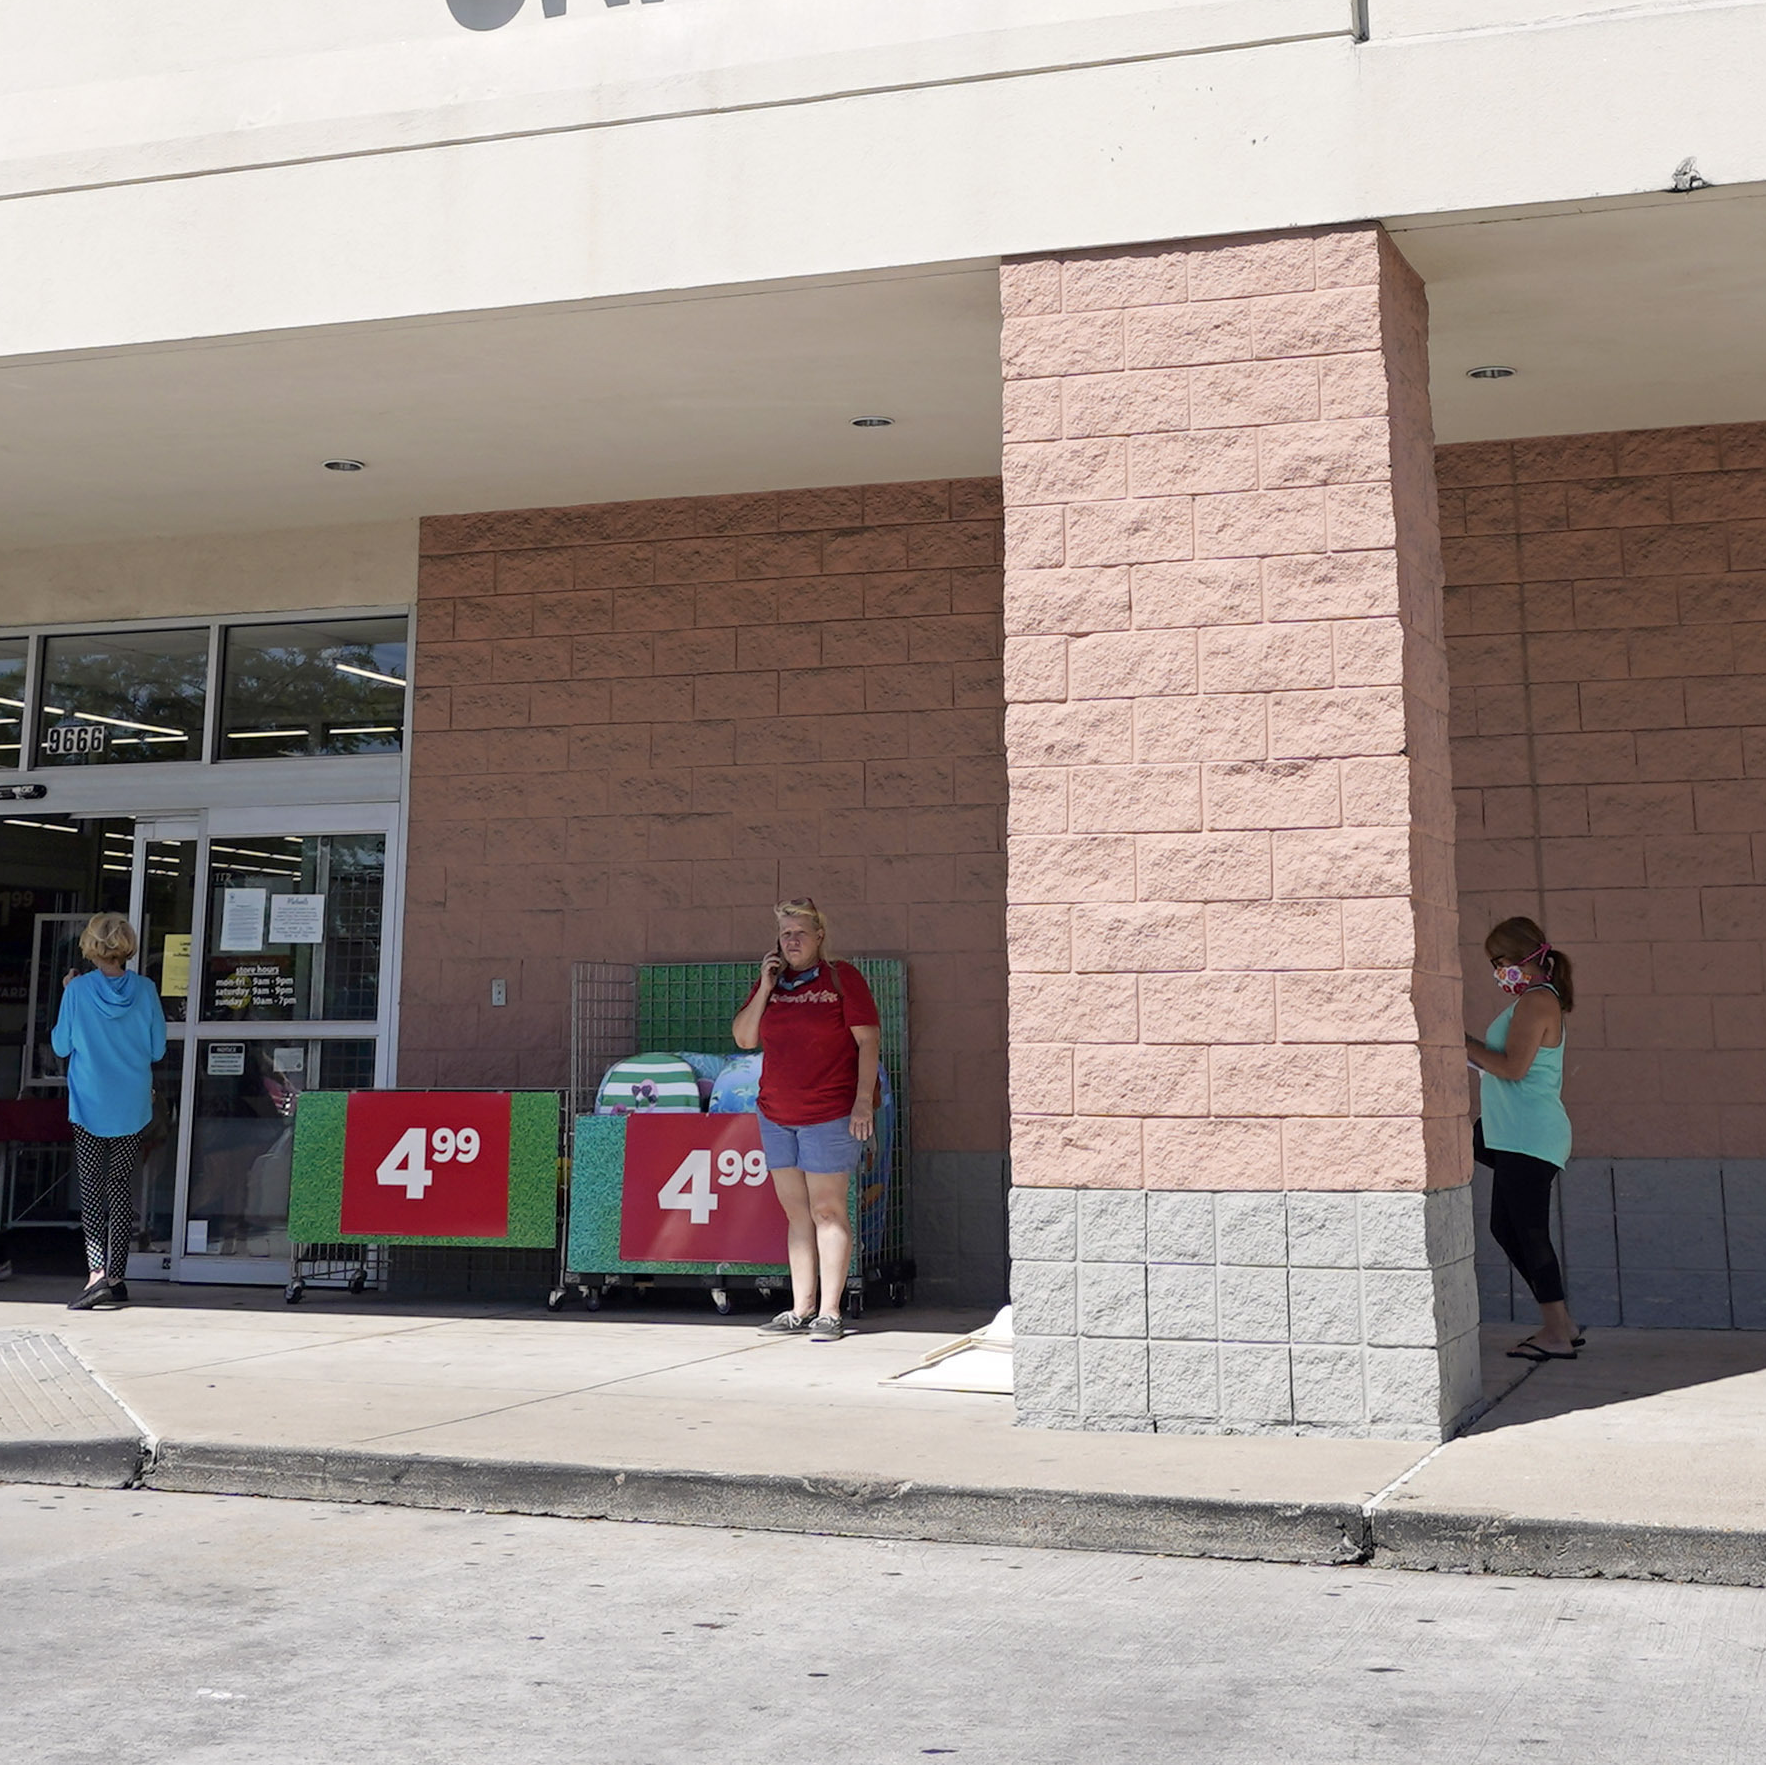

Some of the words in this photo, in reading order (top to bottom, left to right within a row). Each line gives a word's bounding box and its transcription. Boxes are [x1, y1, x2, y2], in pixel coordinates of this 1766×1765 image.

[49, 727, 102, 753] 9666
[236, 966, 256, 975] store
[257, 965, 280, 975] hours
[252, 977, 270, 986] 9am
[275, 976, 294, 986] 9pm
[215, 987, 250, 997] saturday
[252, 987, 270, 995] 9am
[275, 986, 293, 996] 9pm
[215, 997, 244, 1008] sunday
[252, 997, 273, 1005] 10am
[278, 996, 297, 1006] 7pm
